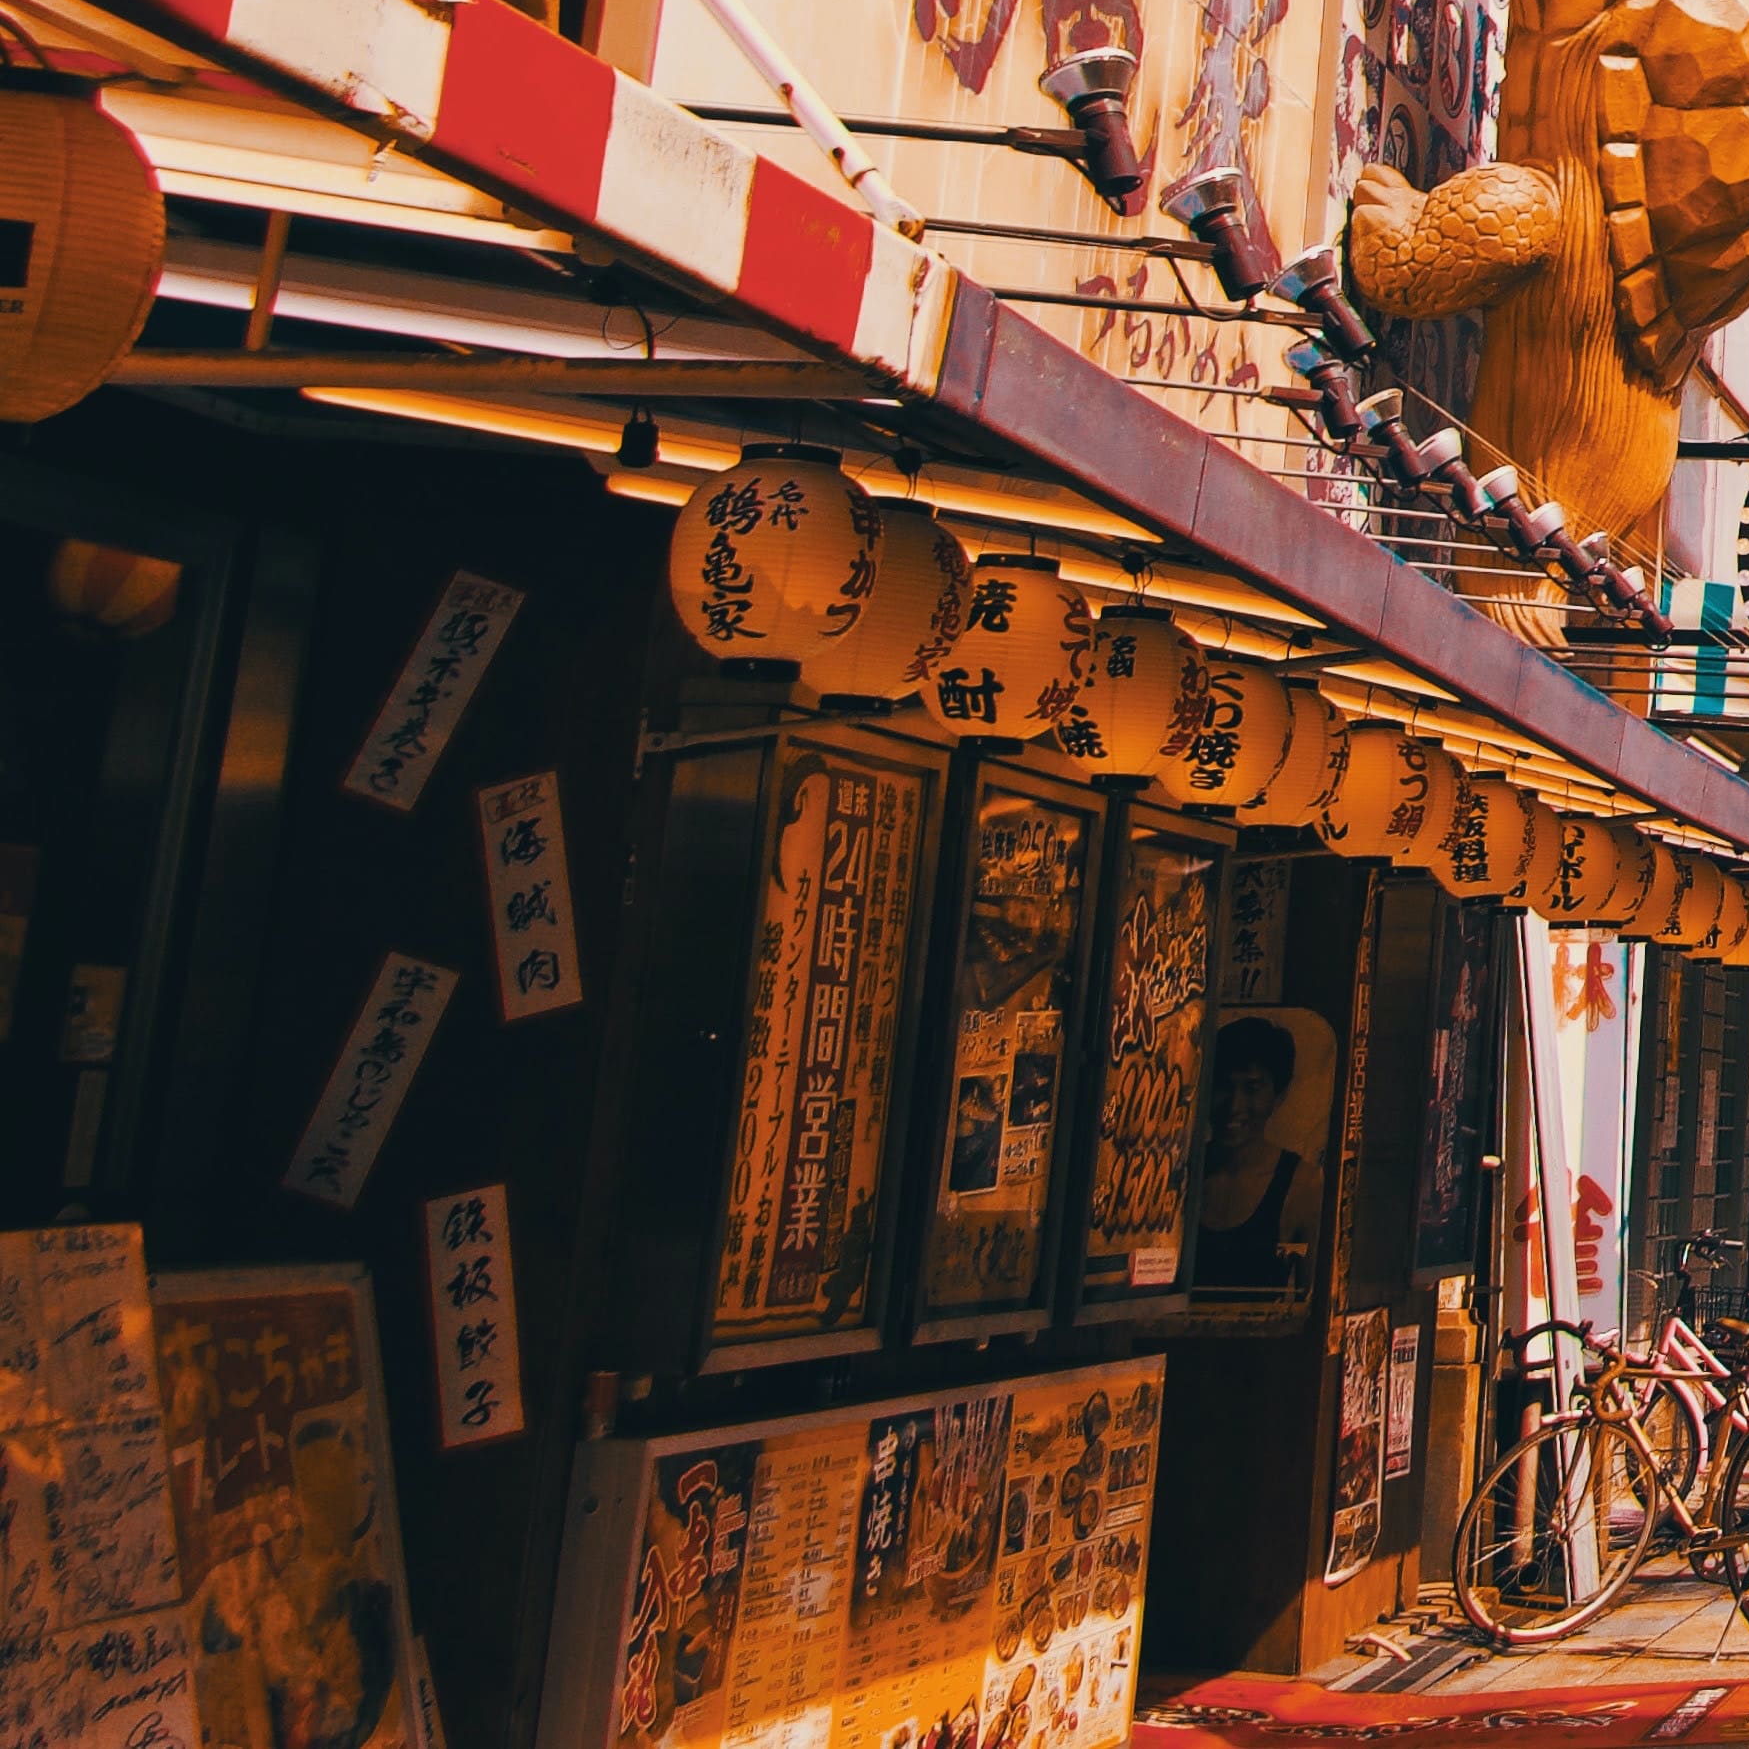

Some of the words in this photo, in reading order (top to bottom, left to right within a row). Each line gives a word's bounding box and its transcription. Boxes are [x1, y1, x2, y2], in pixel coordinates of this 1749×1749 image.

[701, 478, 767, 641] 鶴亀家
[767, 481, 808, 531] 名代
[821, 486, 884, 637] 串かつ
